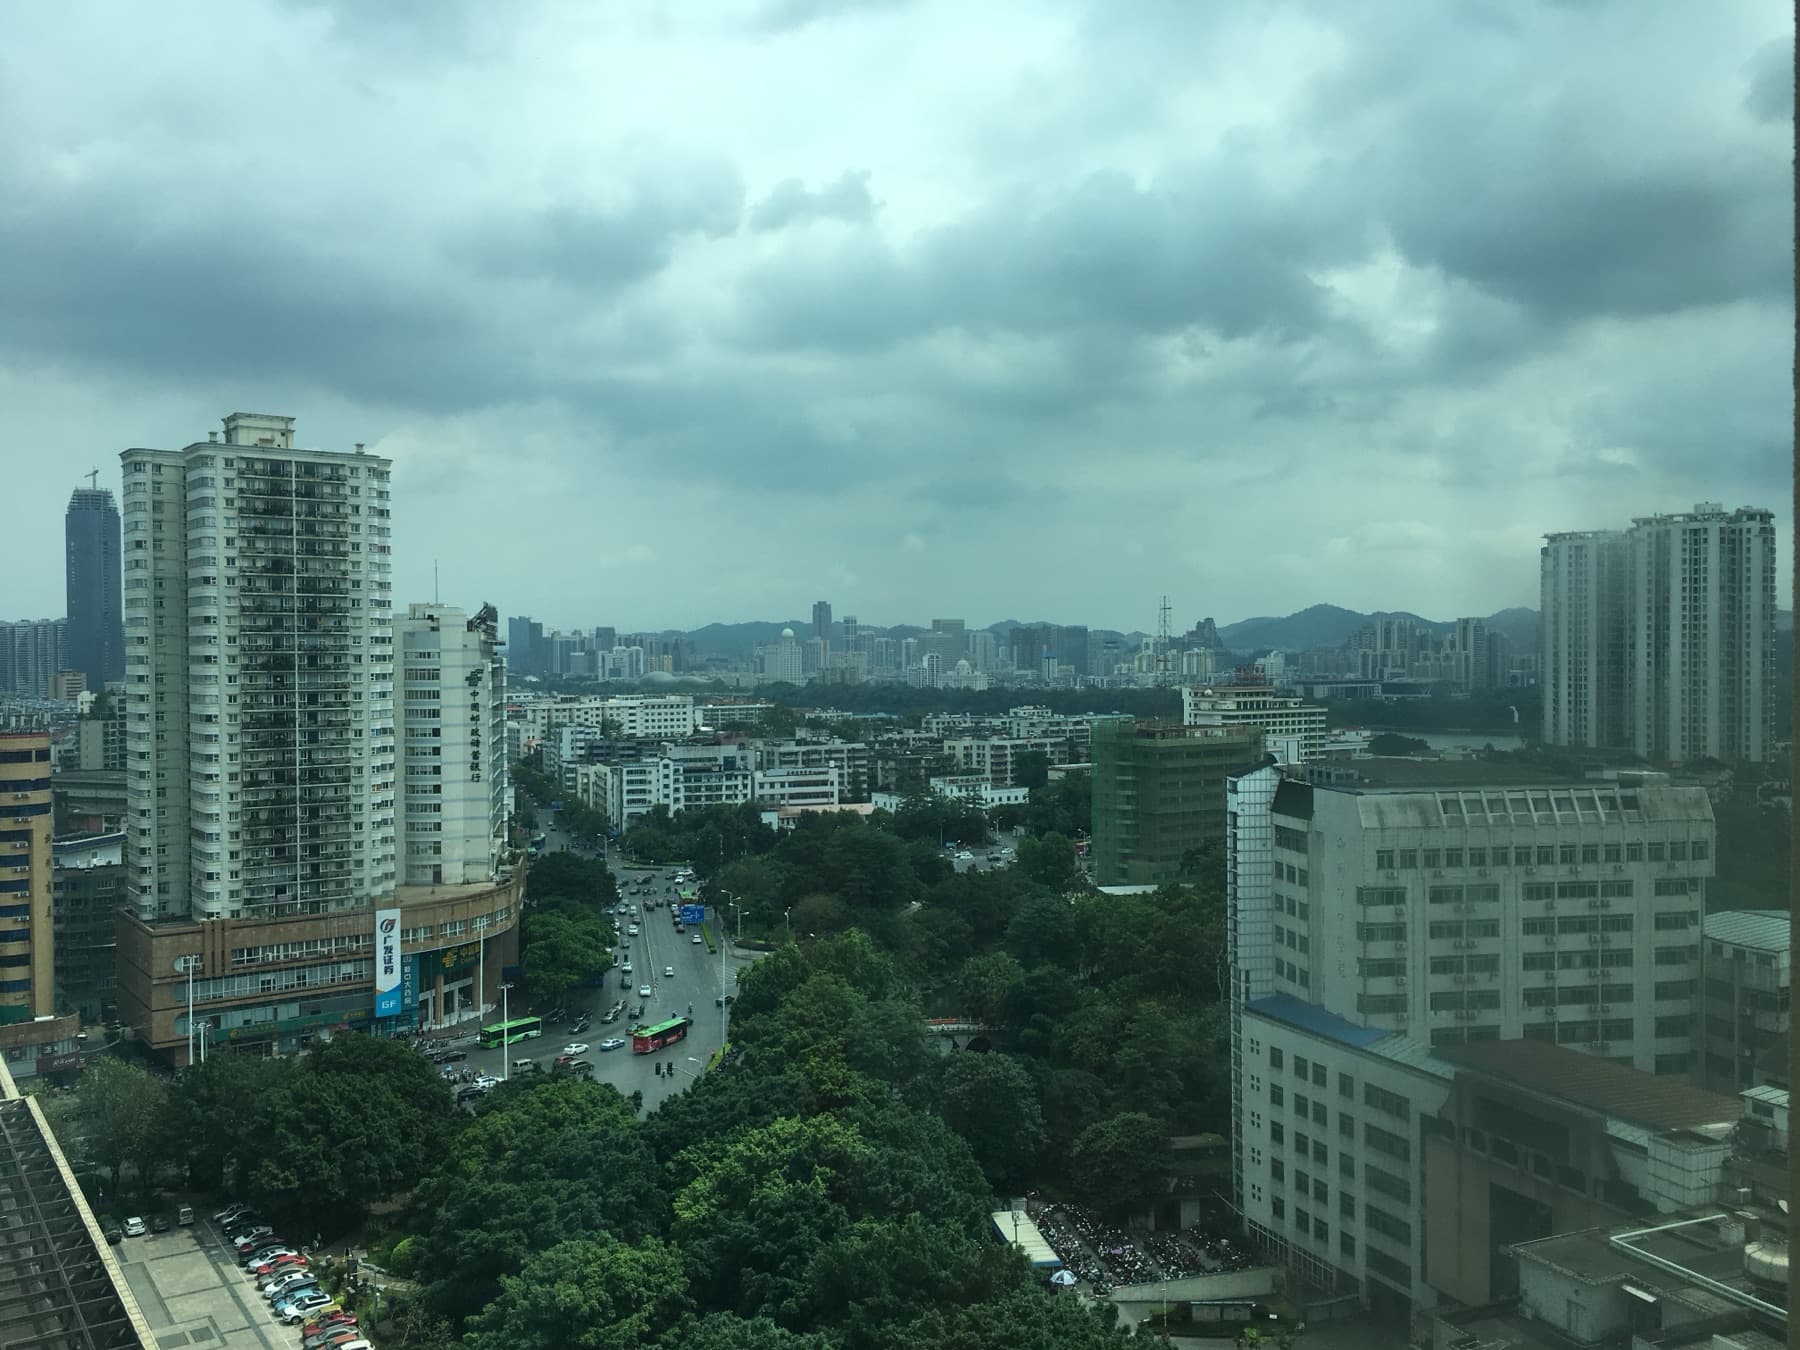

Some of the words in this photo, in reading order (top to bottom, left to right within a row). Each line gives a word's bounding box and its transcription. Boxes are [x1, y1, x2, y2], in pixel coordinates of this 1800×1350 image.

[383, 935, 394, 975] 广发证券
[381, 1000, 397, 1009] GF
